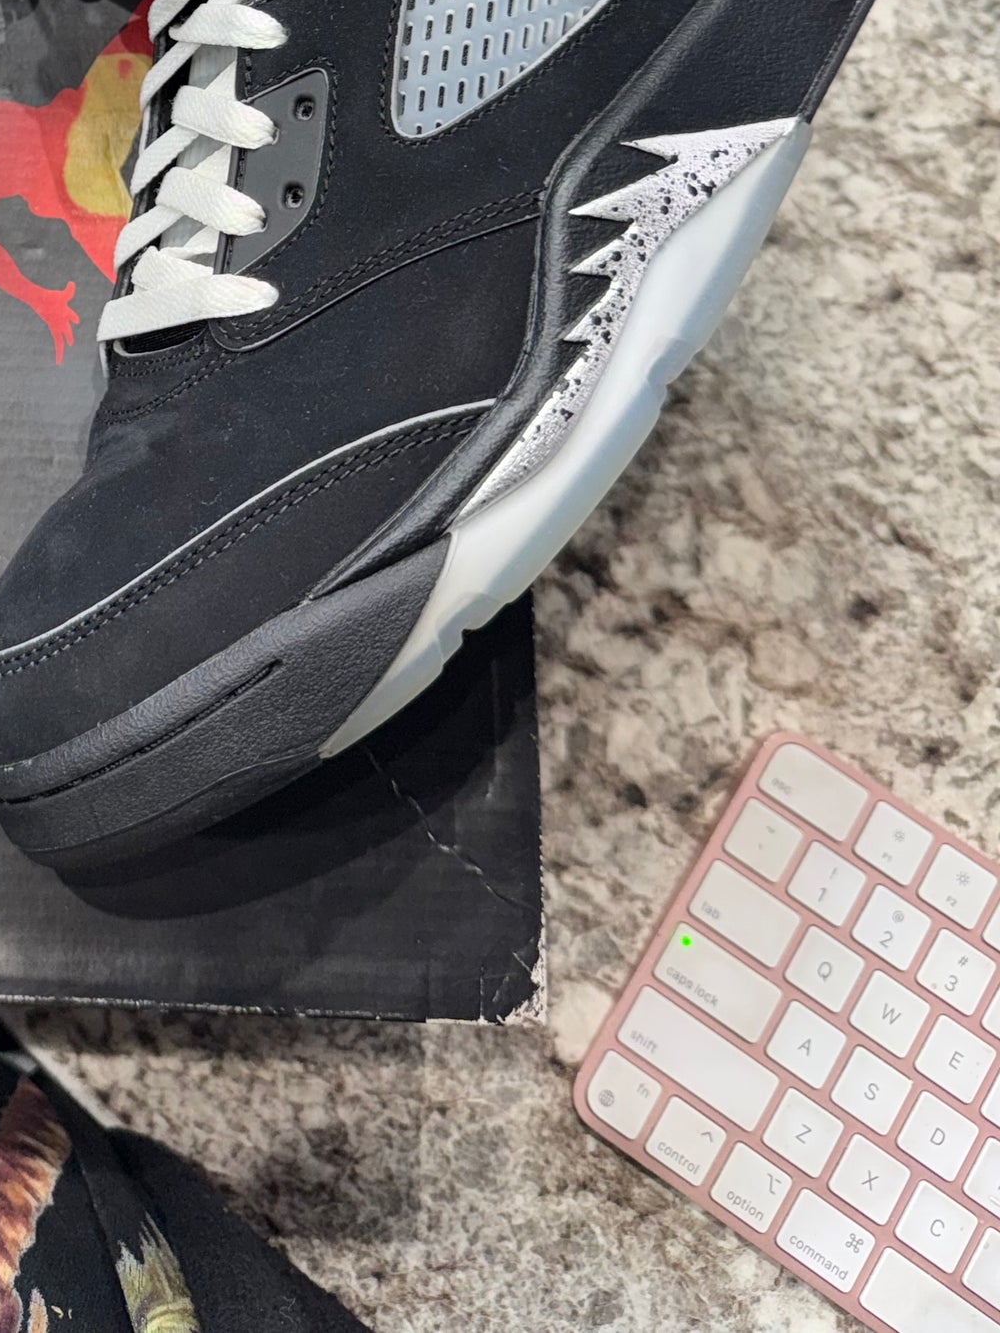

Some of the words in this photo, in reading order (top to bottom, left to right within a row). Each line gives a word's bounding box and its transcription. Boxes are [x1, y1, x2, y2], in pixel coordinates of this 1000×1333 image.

[818, 888, 827, 902] 1
[701, 901, 720, 920] tab
[892, 911, 904, 923] @
[880, 931, 893, 948] 2
[958, 956, 968, 966] #
[817, 962, 832, 981] Q
[666, 966, 693, 990] caps
[693, 985, 719, 1007] lock
[945, 975, 958, 991] 3
[882, 1003, 901, 1024] W
[630, 1029, 658, 1054] shift
[798, 1039, 811, 1056] A
[949, 1051, 964, 1069] E
[637, 1083, 649, 1098] fn
[864, 1083, 879, 1100] S
[796, 1124, 812, 1143] Z
[930, 1128, 945, 1145] D
[657, 1141, 700, 1175] control
[862, 1170, 879, 1190] X
[726, 1191, 764, 1222] option
[930, 1219, 944, 1237] C
[789, 1235, 849, 1281] command
